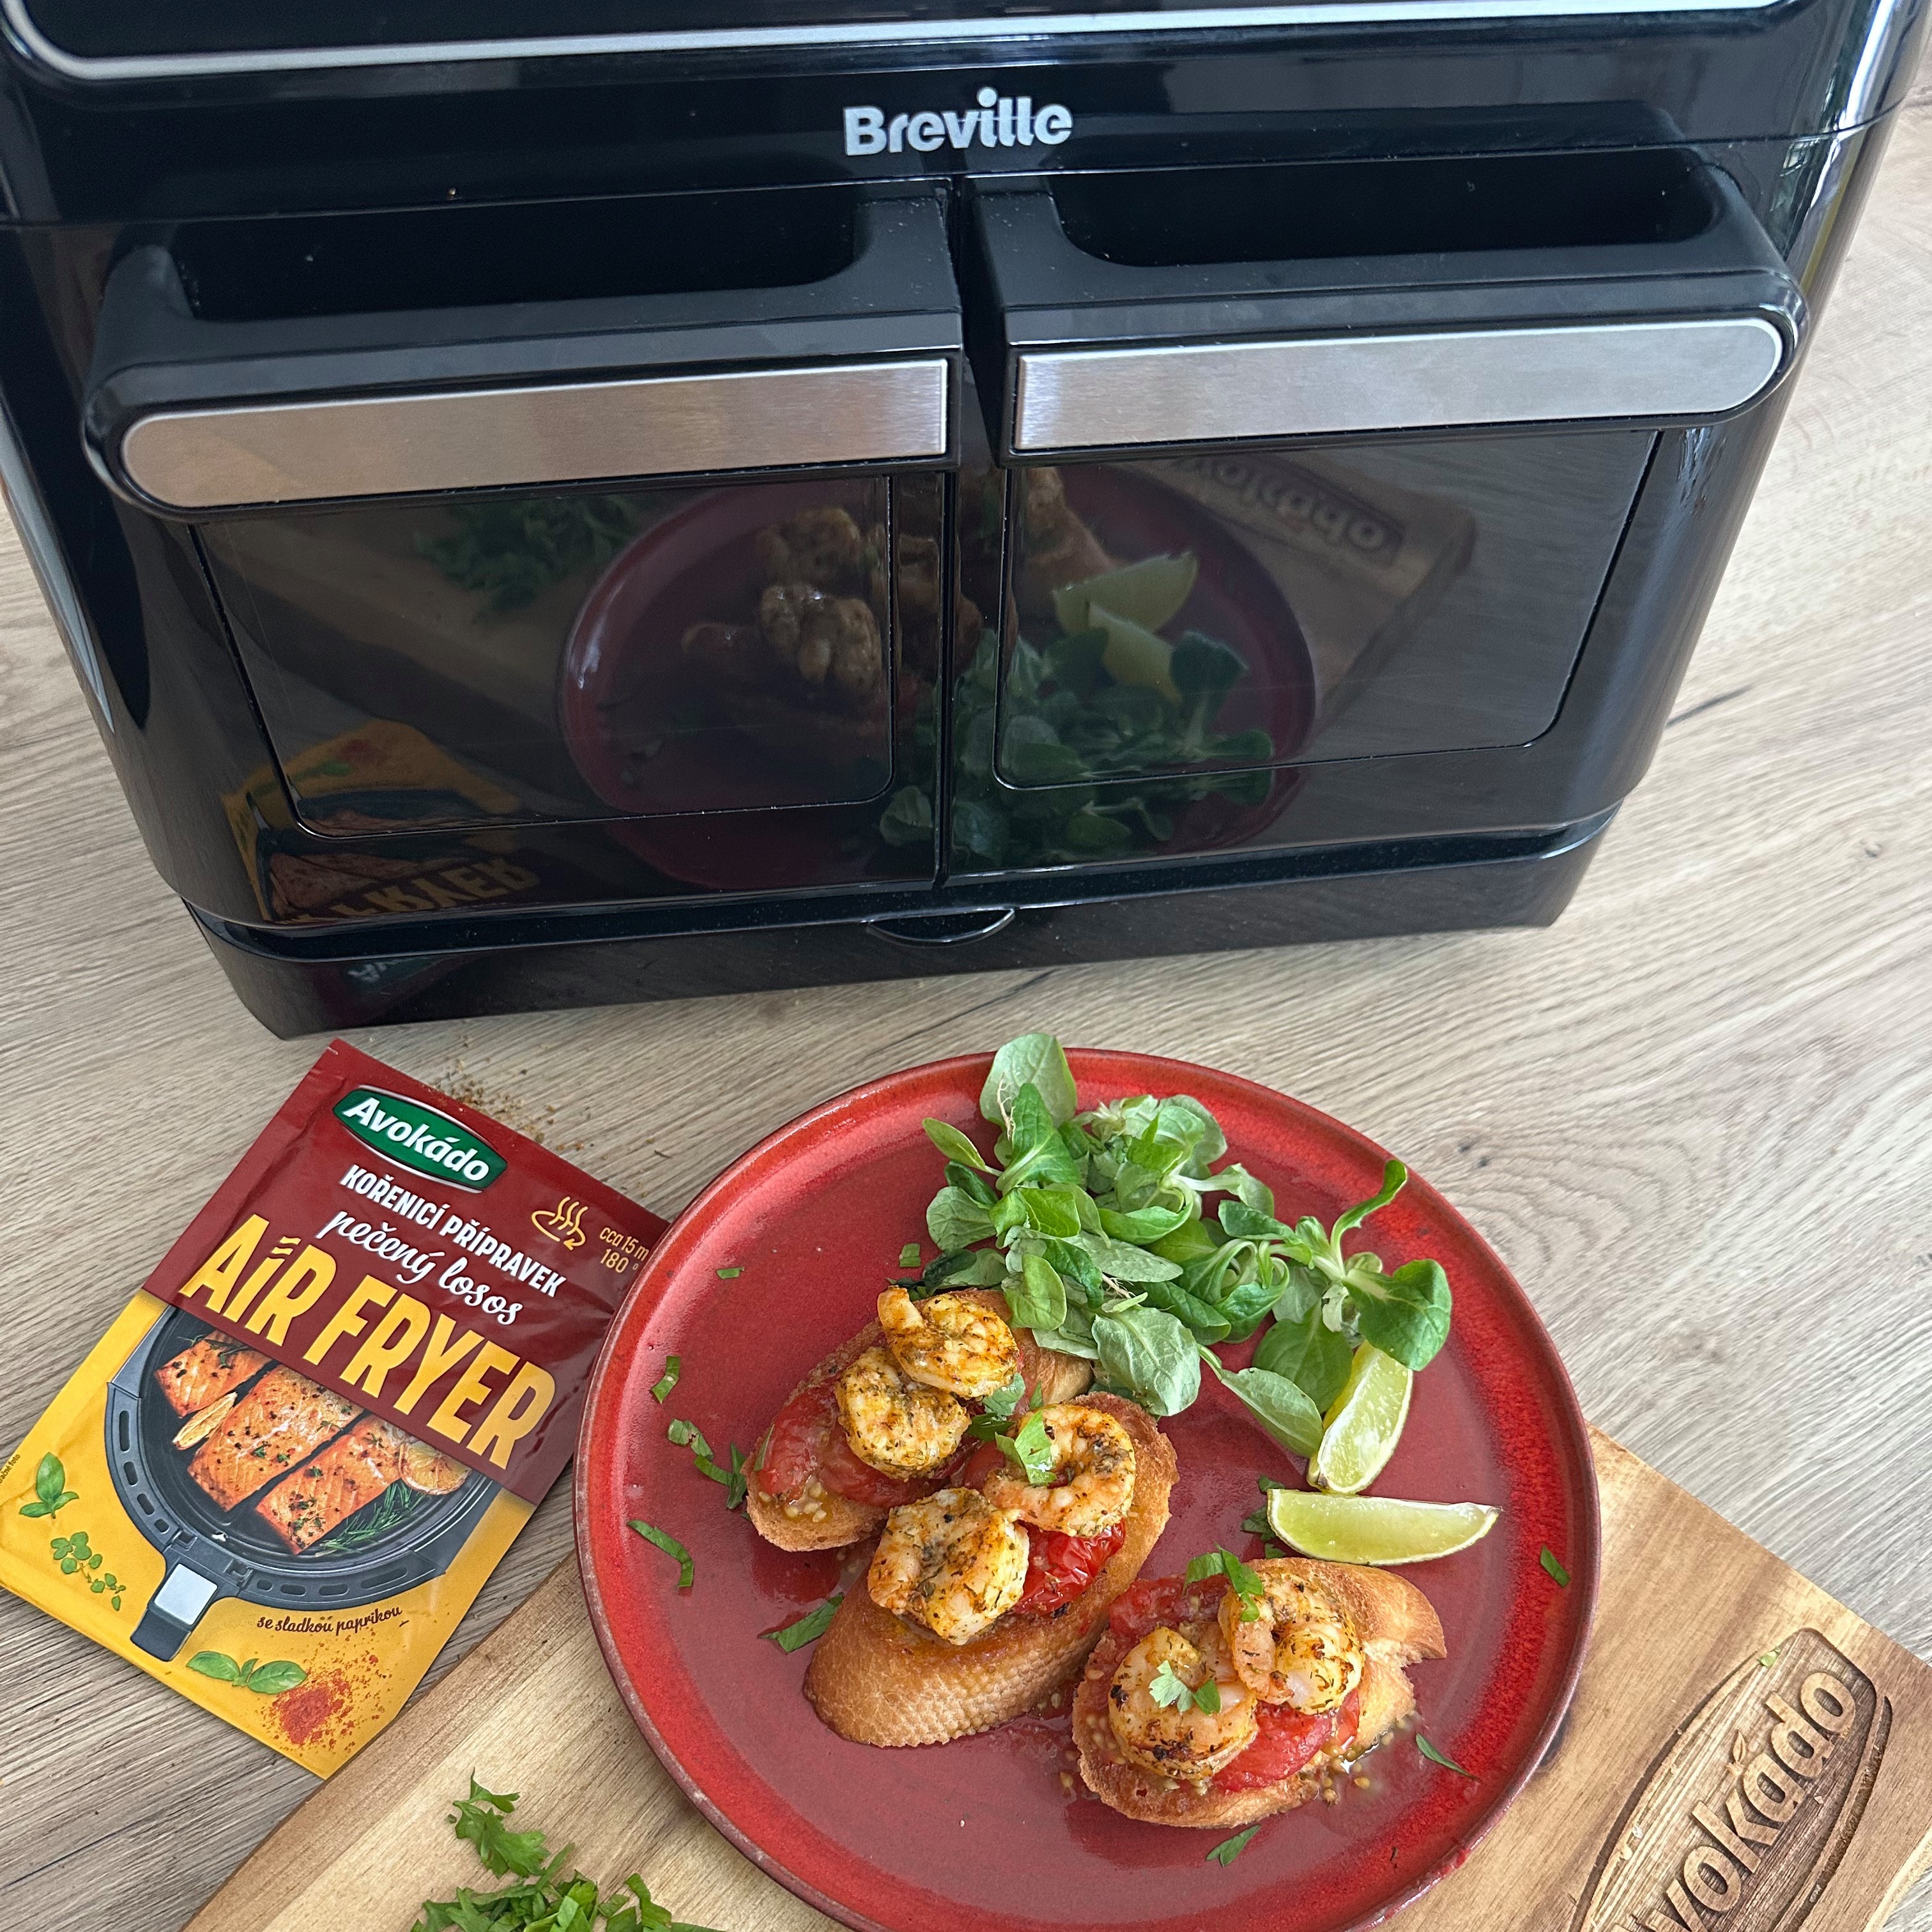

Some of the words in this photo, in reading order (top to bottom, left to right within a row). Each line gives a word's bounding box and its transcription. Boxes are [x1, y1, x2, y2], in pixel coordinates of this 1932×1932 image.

[843, 87, 1073, 156] Breville
[342, 1097, 490, 1181] Avokádo
[316, 1211, 445, 1284] pečený
[439, 1257, 523, 1325] losos
[340, 1164, 450, 1230] KOŘENICÍ
[440, 1215, 567, 1298] PŘÍPRAVEK
[599, 1227, 624, 1247] cca
[621, 1236, 640, 1254] 15
[601, 1248, 629, 1273] 180
[303, 1274, 556, 1470] FRYER
[8, 1453, 21, 1466] foto
[257, 1616, 273, 1629] se
[275, 1616, 334, 1633] sladkou
[336, 1606, 402, 1636] paprikou
[1610, 1671, 1857, 1932] vokádo
